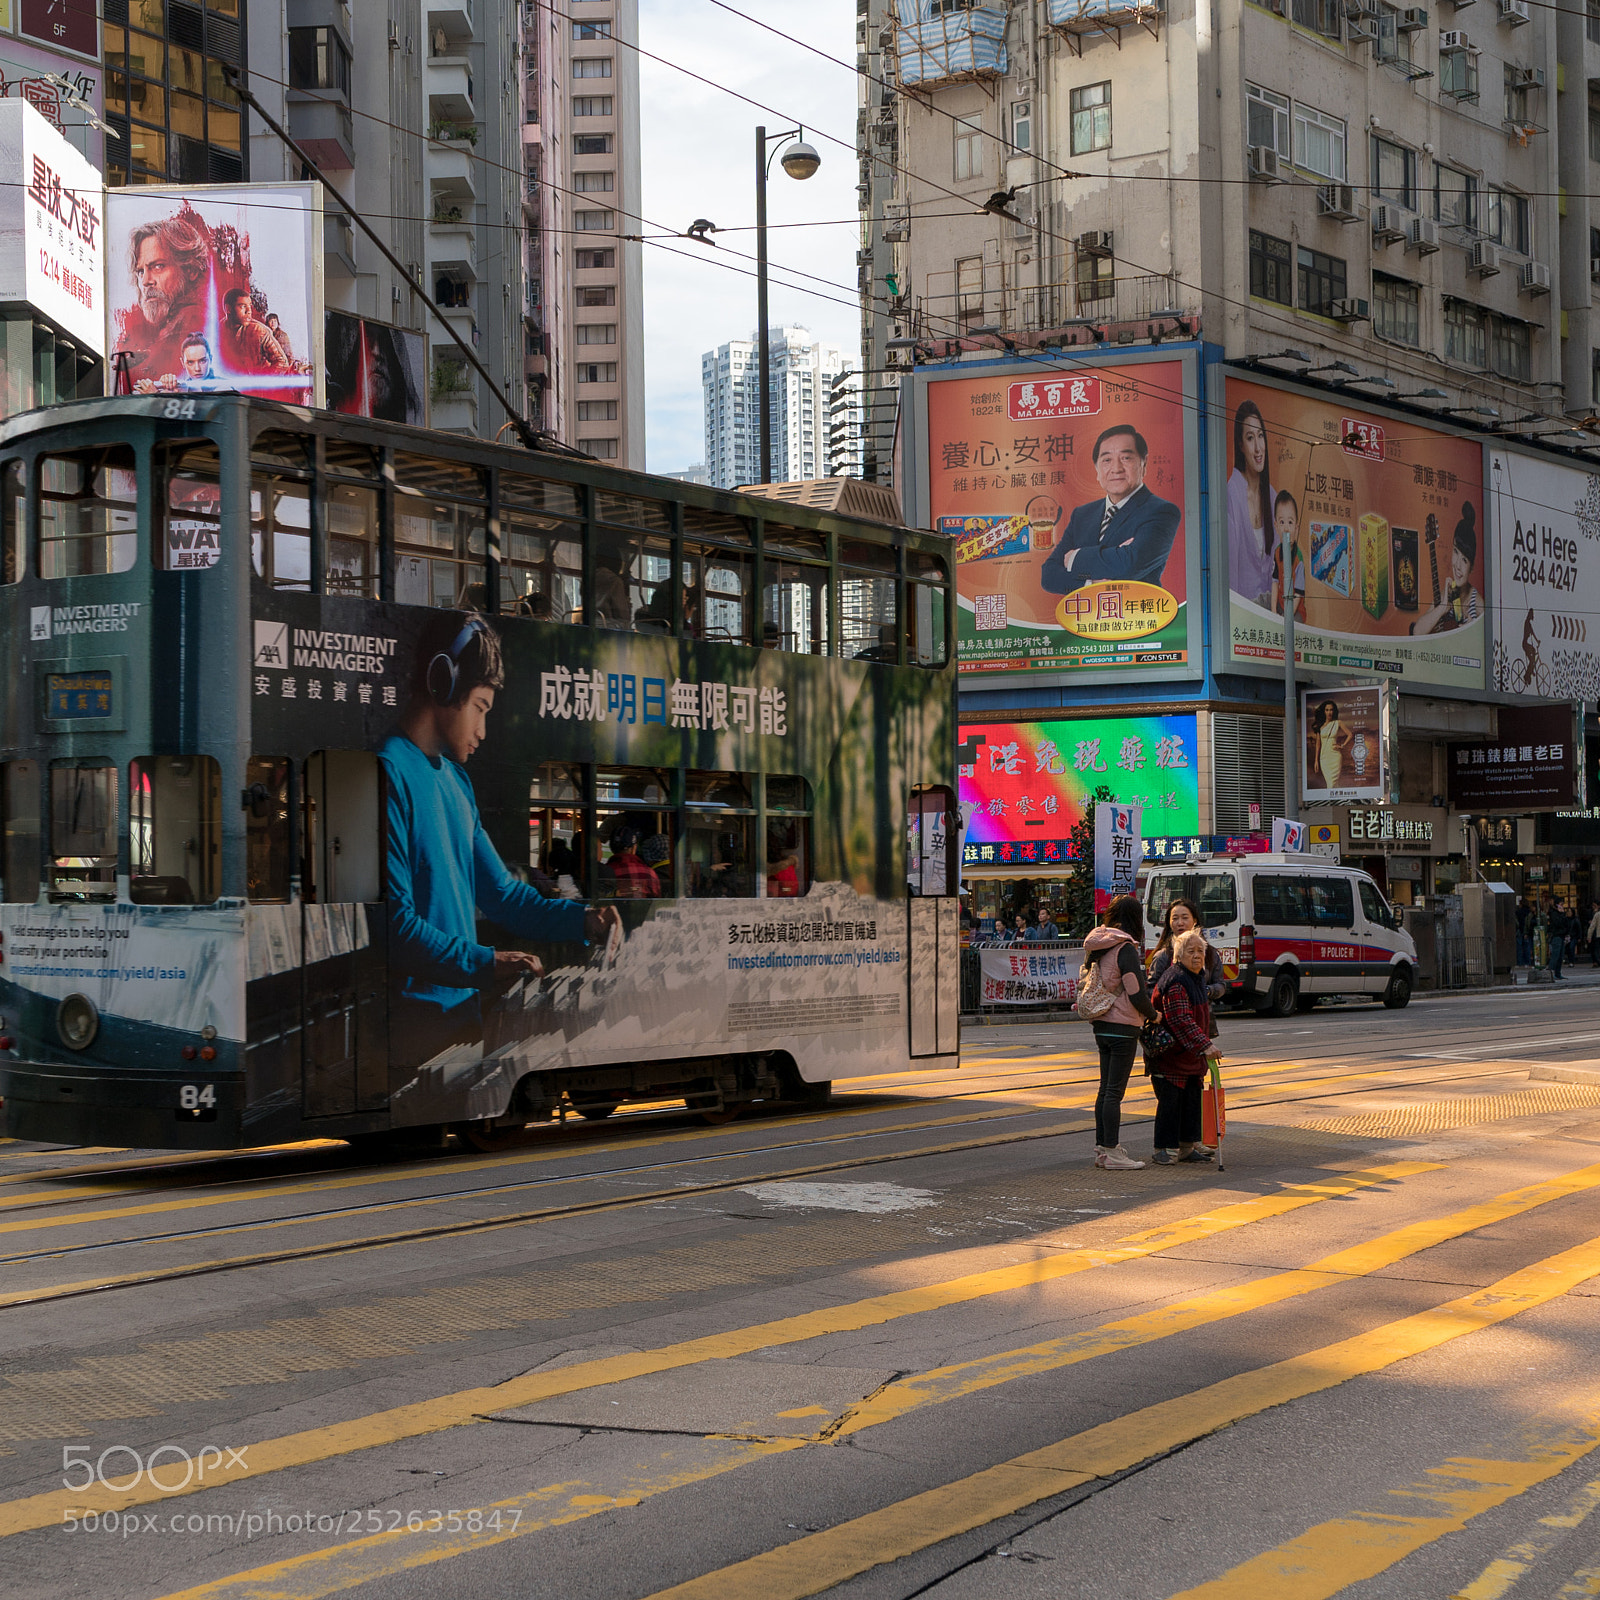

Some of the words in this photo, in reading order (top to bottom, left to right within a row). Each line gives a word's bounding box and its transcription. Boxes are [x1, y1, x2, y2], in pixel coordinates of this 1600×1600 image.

[53, 23, 66, 36] 5F
[40, 247, 60, 284] 12.14
[1105, 382, 1139, 393] SINCE
[1107, 393, 1139, 403] 1822
[163, 400, 197, 419] 84
[971, 405, 1004, 416] 1822年
[1017, 410, 1033, 418] MA
[1035, 408, 1055, 416] PAK
[1058, 405, 1090, 414] LEUNG
[953, 471, 1066, 492] 維持心臟健康
[1513, 520, 1537, 555] Ad
[1542, 526, 1578, 563] Here
[1513, 554, 1545, 586] 2864
[1548, 562, 1578, 592] 4247
[54, 602, 142, 621] INVESTMENT
[54, 618, 128, 635] MANAGERS
[293, 628, 399, 656] INVESTMENT
[1082, 645, 1097, 653] 2543
[1099, 644, 1114, 652] 1018
[293, 650, 385, 674] MANAGERS
[1158, 653, 1178, 661] STYLE
[254, 674, 399, 706] 安盛投資管理
[539, 664, 788, 736] 成就明日無限可能
[27, 925, 68, 940] strategies
[69, 927, 80, 938] to
[82, 926, 106, 941] help
[107, 929, 130, 941] you
[40, 947, 61, 960] your
[63, 945, 109, 960] portfolio
[728, 948, 900, 969] investedintomorrow.com/yield/asia
[1327, 946, 1348, 958] POLICE
[180, 1084, 217, 1109] 84
